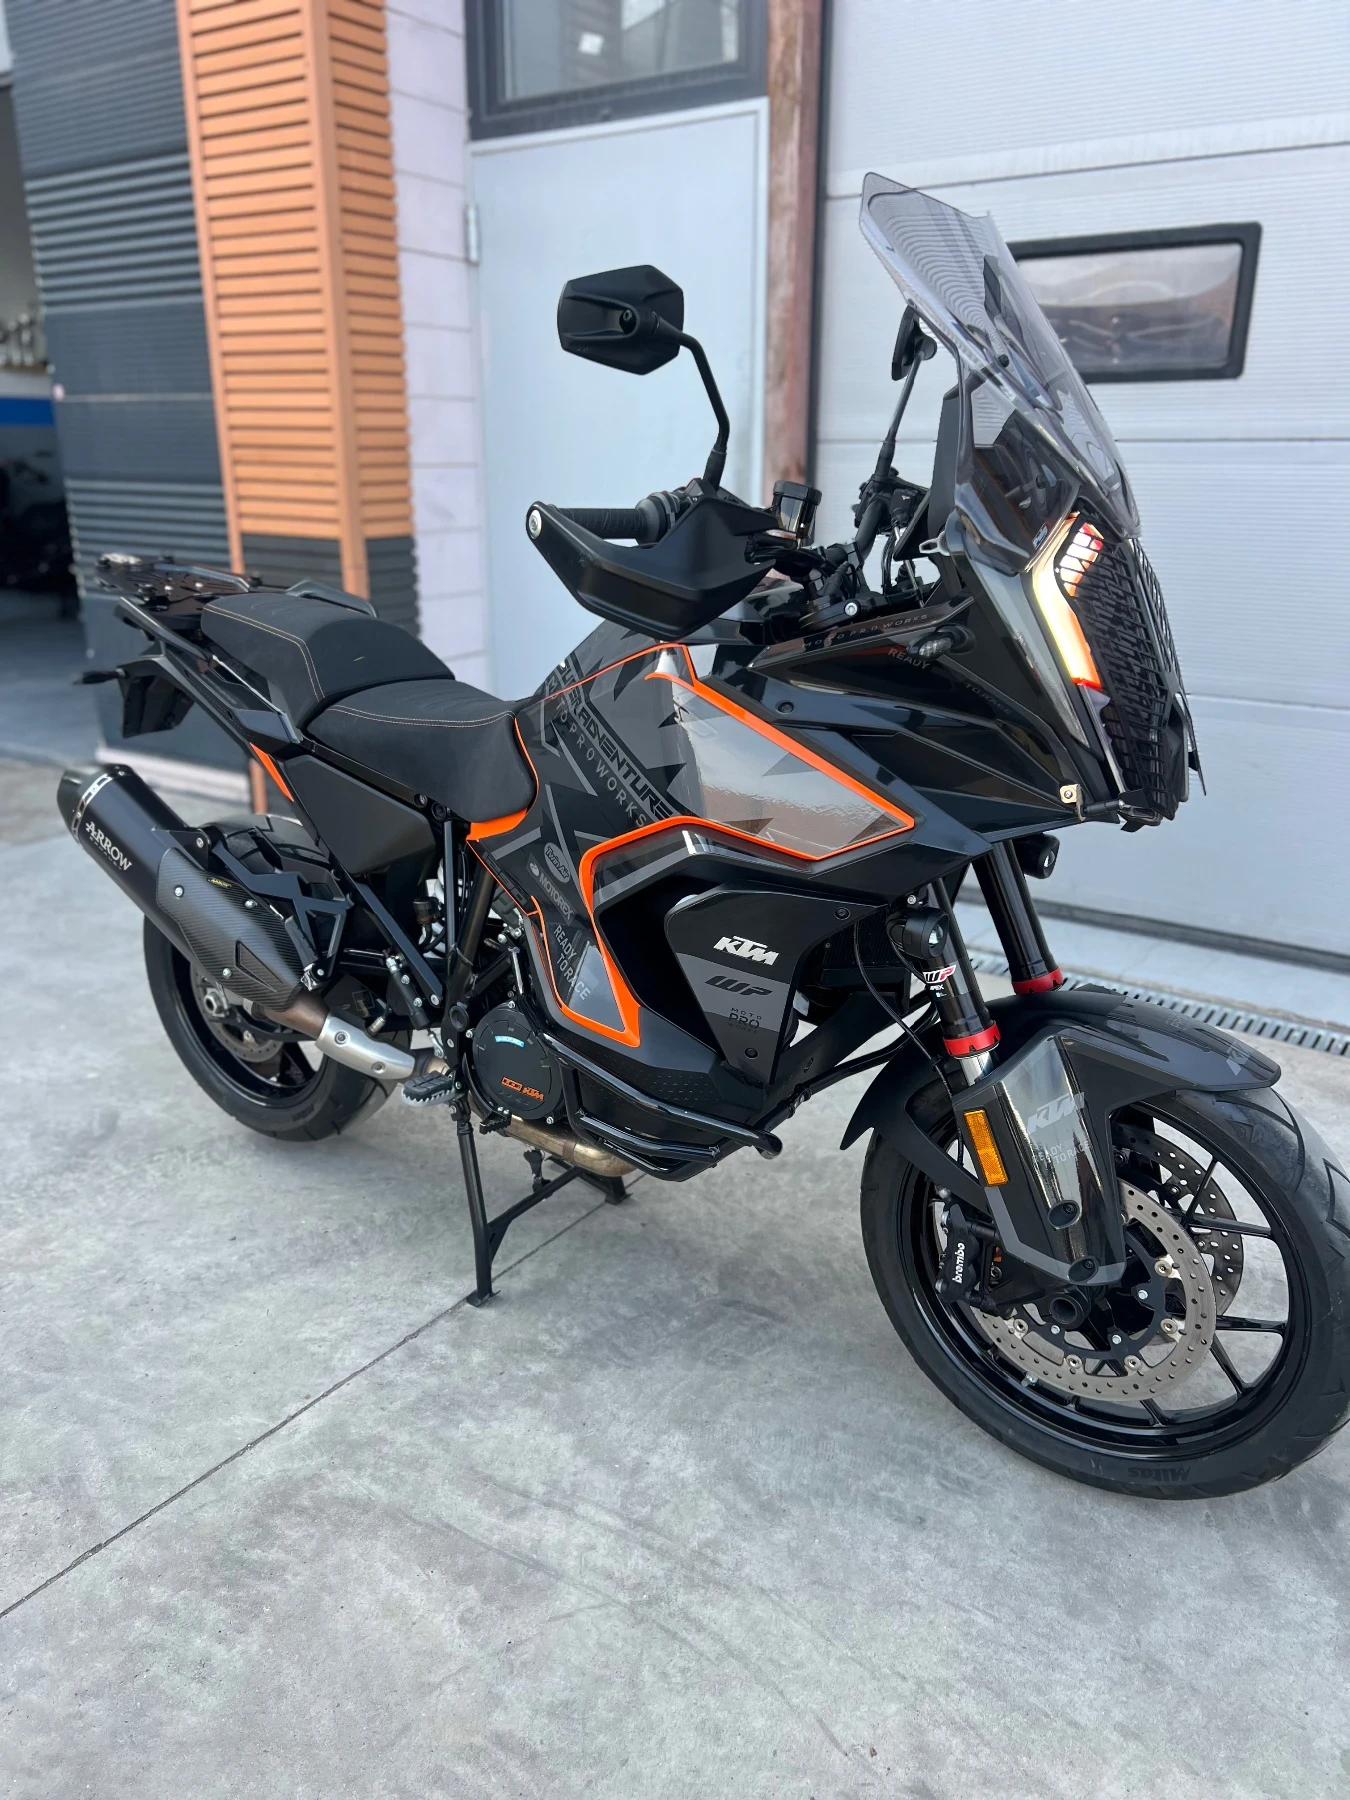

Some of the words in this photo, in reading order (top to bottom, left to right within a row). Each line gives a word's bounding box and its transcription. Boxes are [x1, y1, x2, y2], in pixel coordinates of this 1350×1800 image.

[85, 821, 133, 871] ARROW
[539, 872, 575, 921] MOTOREX
[553, 924, 578, 961] READY
[712, 935, 780, 966] KTM
[556, 954, 567, 971] TO
[564, 968, 591, 1001] RACE
[704, 975, 773, 996] WP
[922, 964, 957, 984] WP
[728, 1012, 760, 1029] PRO
[731, 1007, 762, 1020] MOTO
[1027, 1091, 1085, 1135] KTM
[1032, 1143, 1062, 1163] REDY
[951, 1242, 966, 1284] brembo
[1128, 1465, 1192, 1482] Mitas
